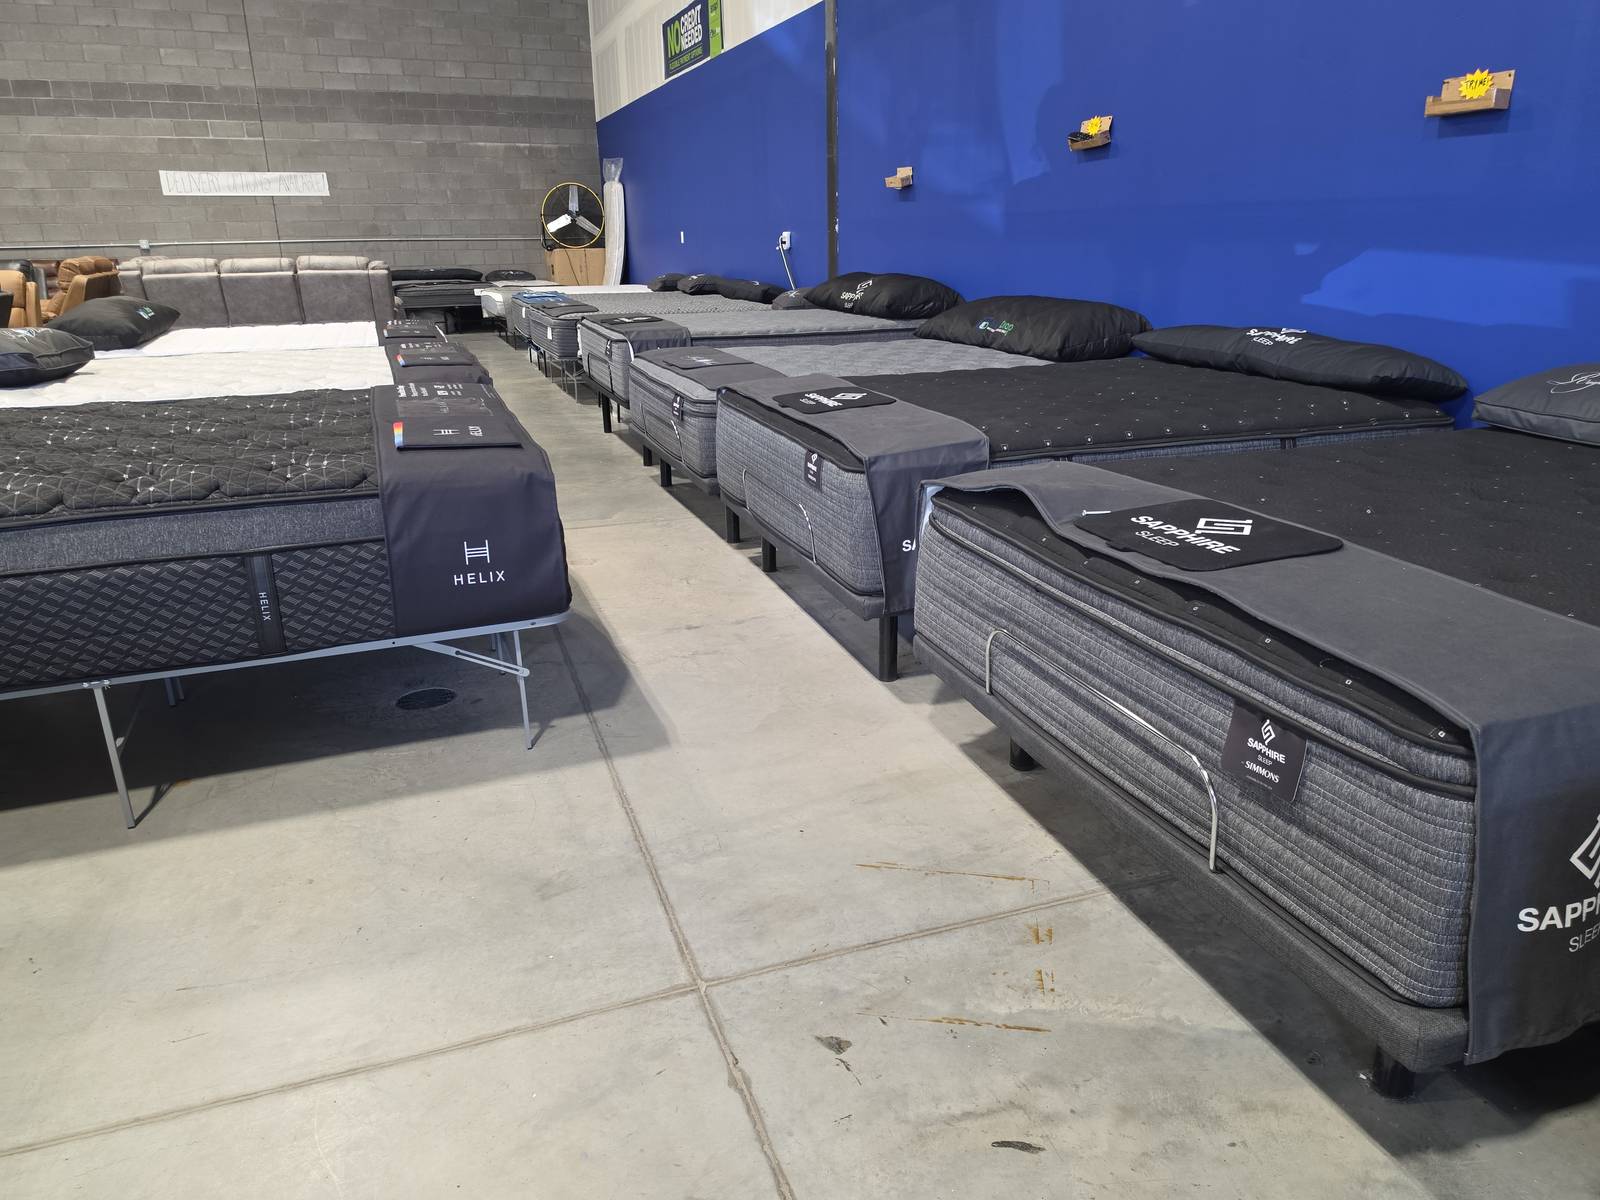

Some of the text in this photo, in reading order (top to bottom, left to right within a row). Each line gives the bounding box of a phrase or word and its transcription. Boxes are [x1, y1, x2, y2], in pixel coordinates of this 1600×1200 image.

[681, 4, 702, 35] CREDIT
[667, 20, 681, 59] NO
[681, 24, 703, 51] NEEDED
[1130, 515, 1241, 555] SAPPHIRE
[1135, 530, 1180, 547] SLEEP
[453, 570, 506, 587] HELIX
[258, 591, 272, 622] HELIX
[1246, 737, 1287, 765] SAPPHIRE
[1257, 754, 1273, 766] SLEEP
[1244, 760, 1281, 784] SIMMONS
